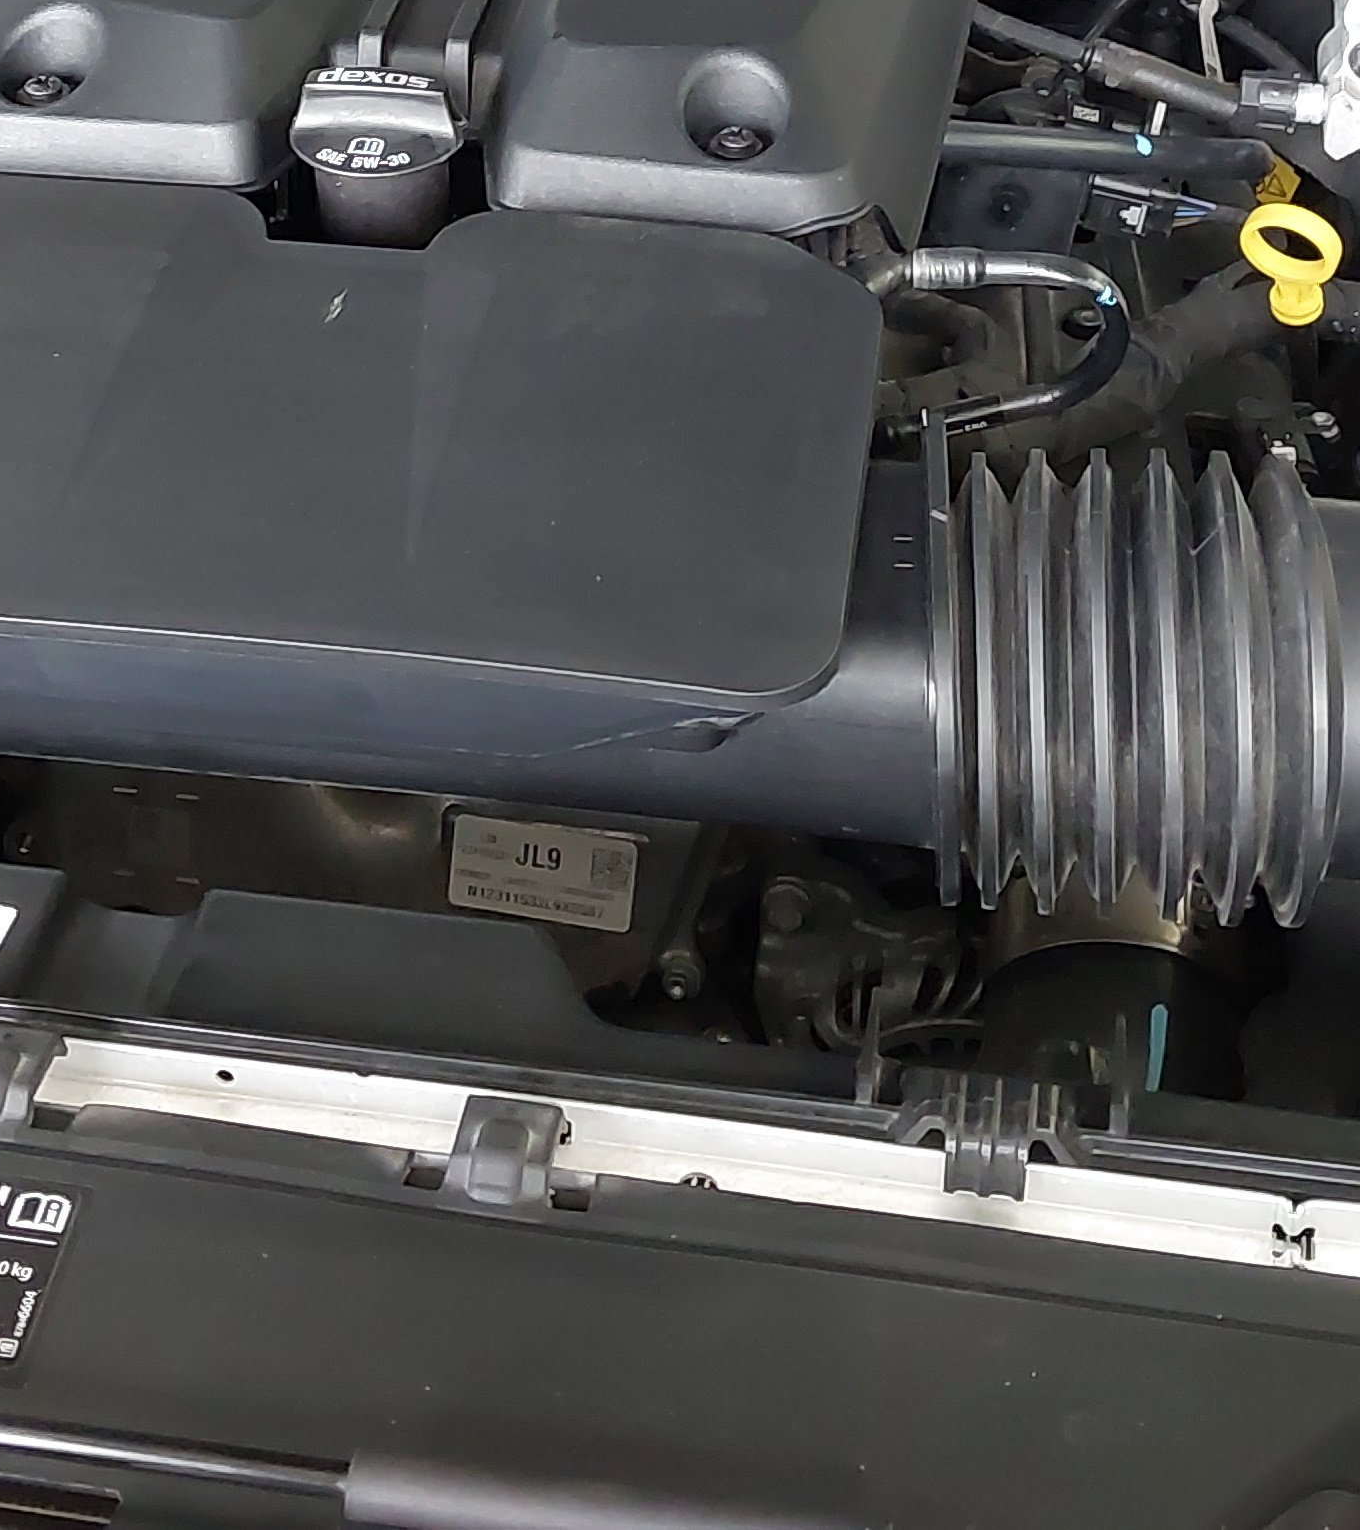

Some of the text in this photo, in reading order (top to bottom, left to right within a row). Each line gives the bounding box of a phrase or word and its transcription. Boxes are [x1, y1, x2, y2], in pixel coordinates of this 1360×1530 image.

[317, 68, 435, 88] dexos
[316, 149, 411, 169] SAE 5W-30
[515, 843, 562, 870] JL9
[11, 1261, 33, 1282] kg
